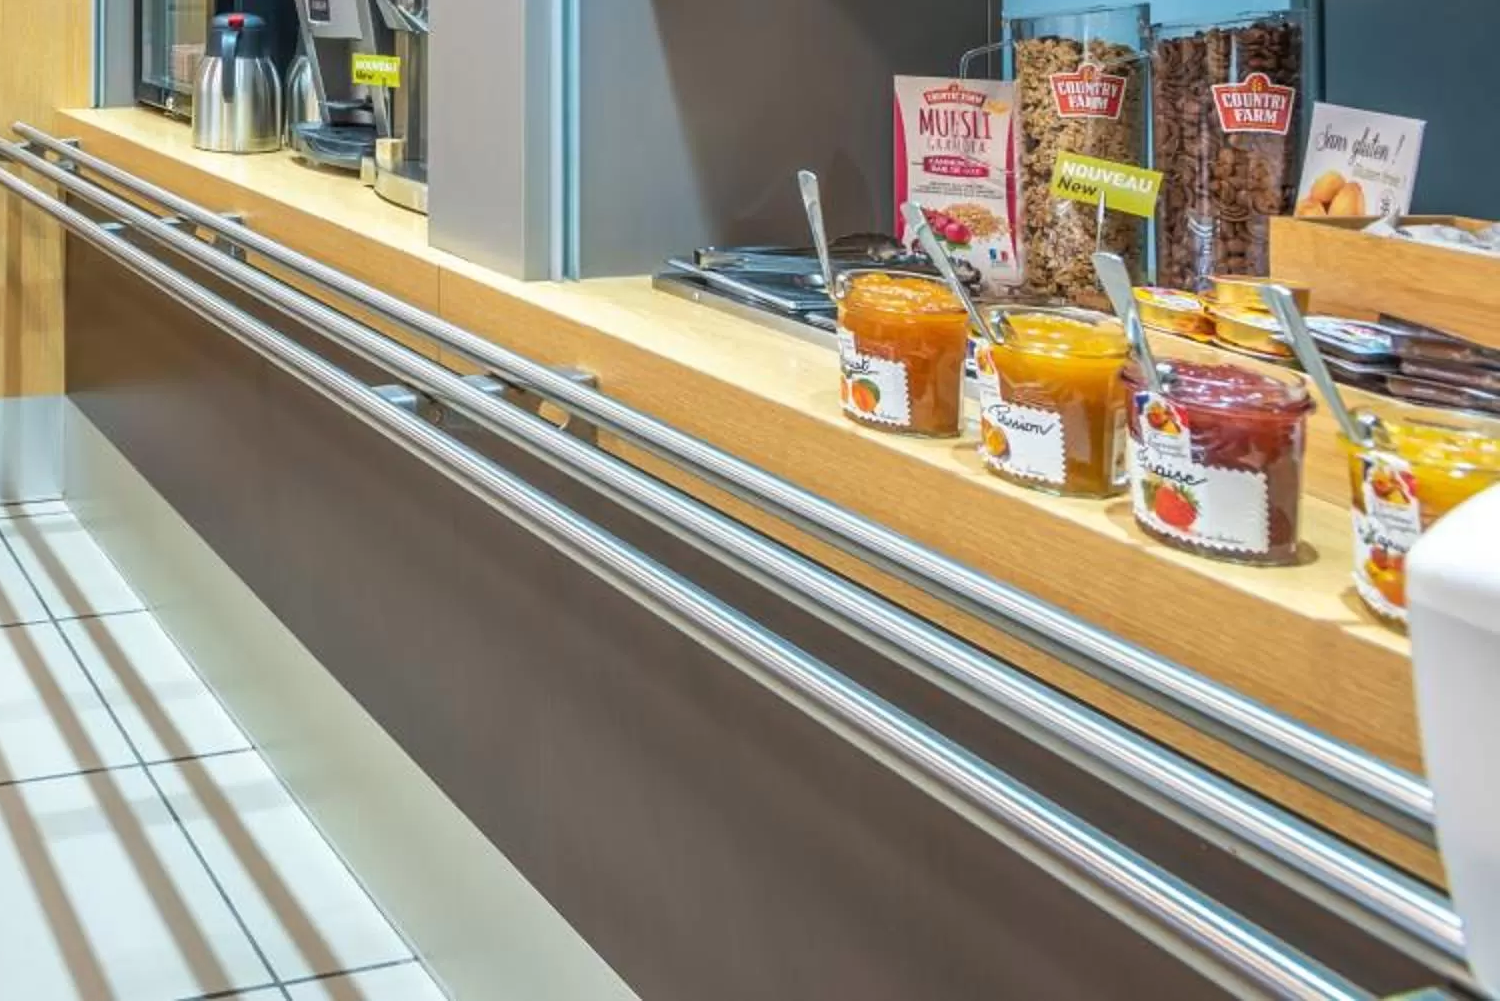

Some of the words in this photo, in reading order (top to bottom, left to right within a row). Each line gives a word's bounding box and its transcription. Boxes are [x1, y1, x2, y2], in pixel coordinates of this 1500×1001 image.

[1057, 81, 1119, 98] COUNTRY
[1068, 96, 1109, 109] FARM
[1221, 92, 1287, 110] COUNTRY
[919, 107, 993, 140] MUESLI
[1234, 108, 1279, 123] FARM
[1347, 126, 1389, 167] gluten
[1056, 175, 1098, 197] New
[1061, 159, 1154, 194] NOUVEAU
